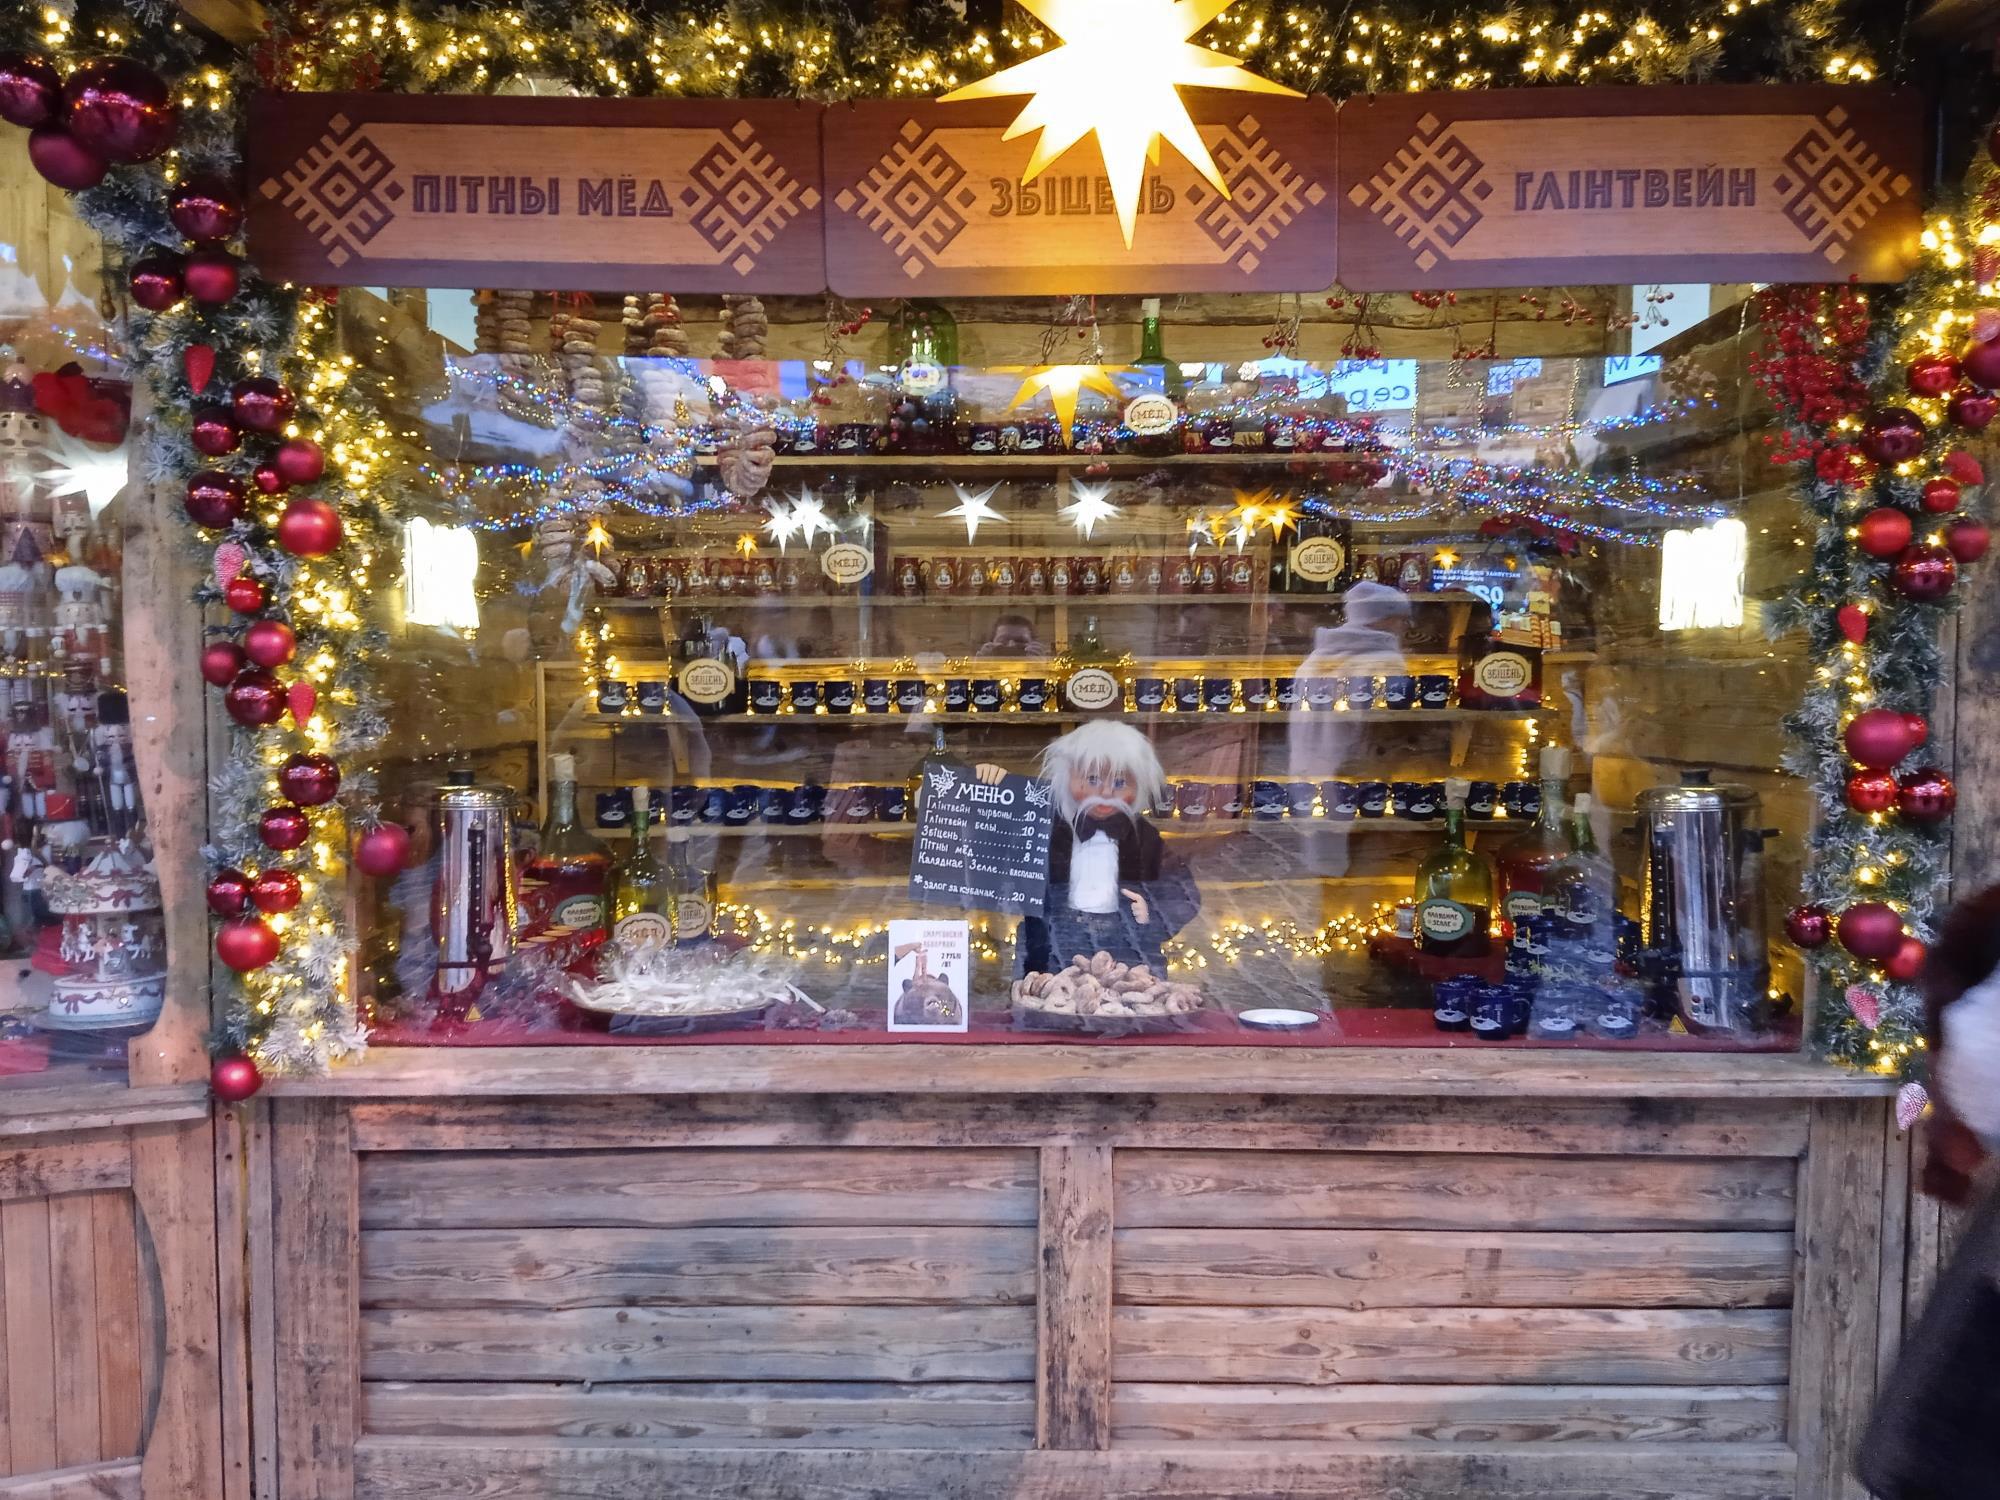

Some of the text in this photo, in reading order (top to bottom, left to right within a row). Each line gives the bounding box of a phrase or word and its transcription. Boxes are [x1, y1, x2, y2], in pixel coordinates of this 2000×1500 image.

[411, 172, 673, 217] ПІТНЫ МЁД
[989, 175, 1176, 217] ЗБІЦЕЬ
[1513, 163, 1756, 211] ГЛІНТВЕЙН
[1078, 682, 1106, 694] МЁД
[955, 783, 1015, 805] МЕНЮ
[926, 795, 971, 814] Глінтвейн
[924, 810, 968, 827] Глінтвейн
[918, 851, 964, 868] Каляднае
